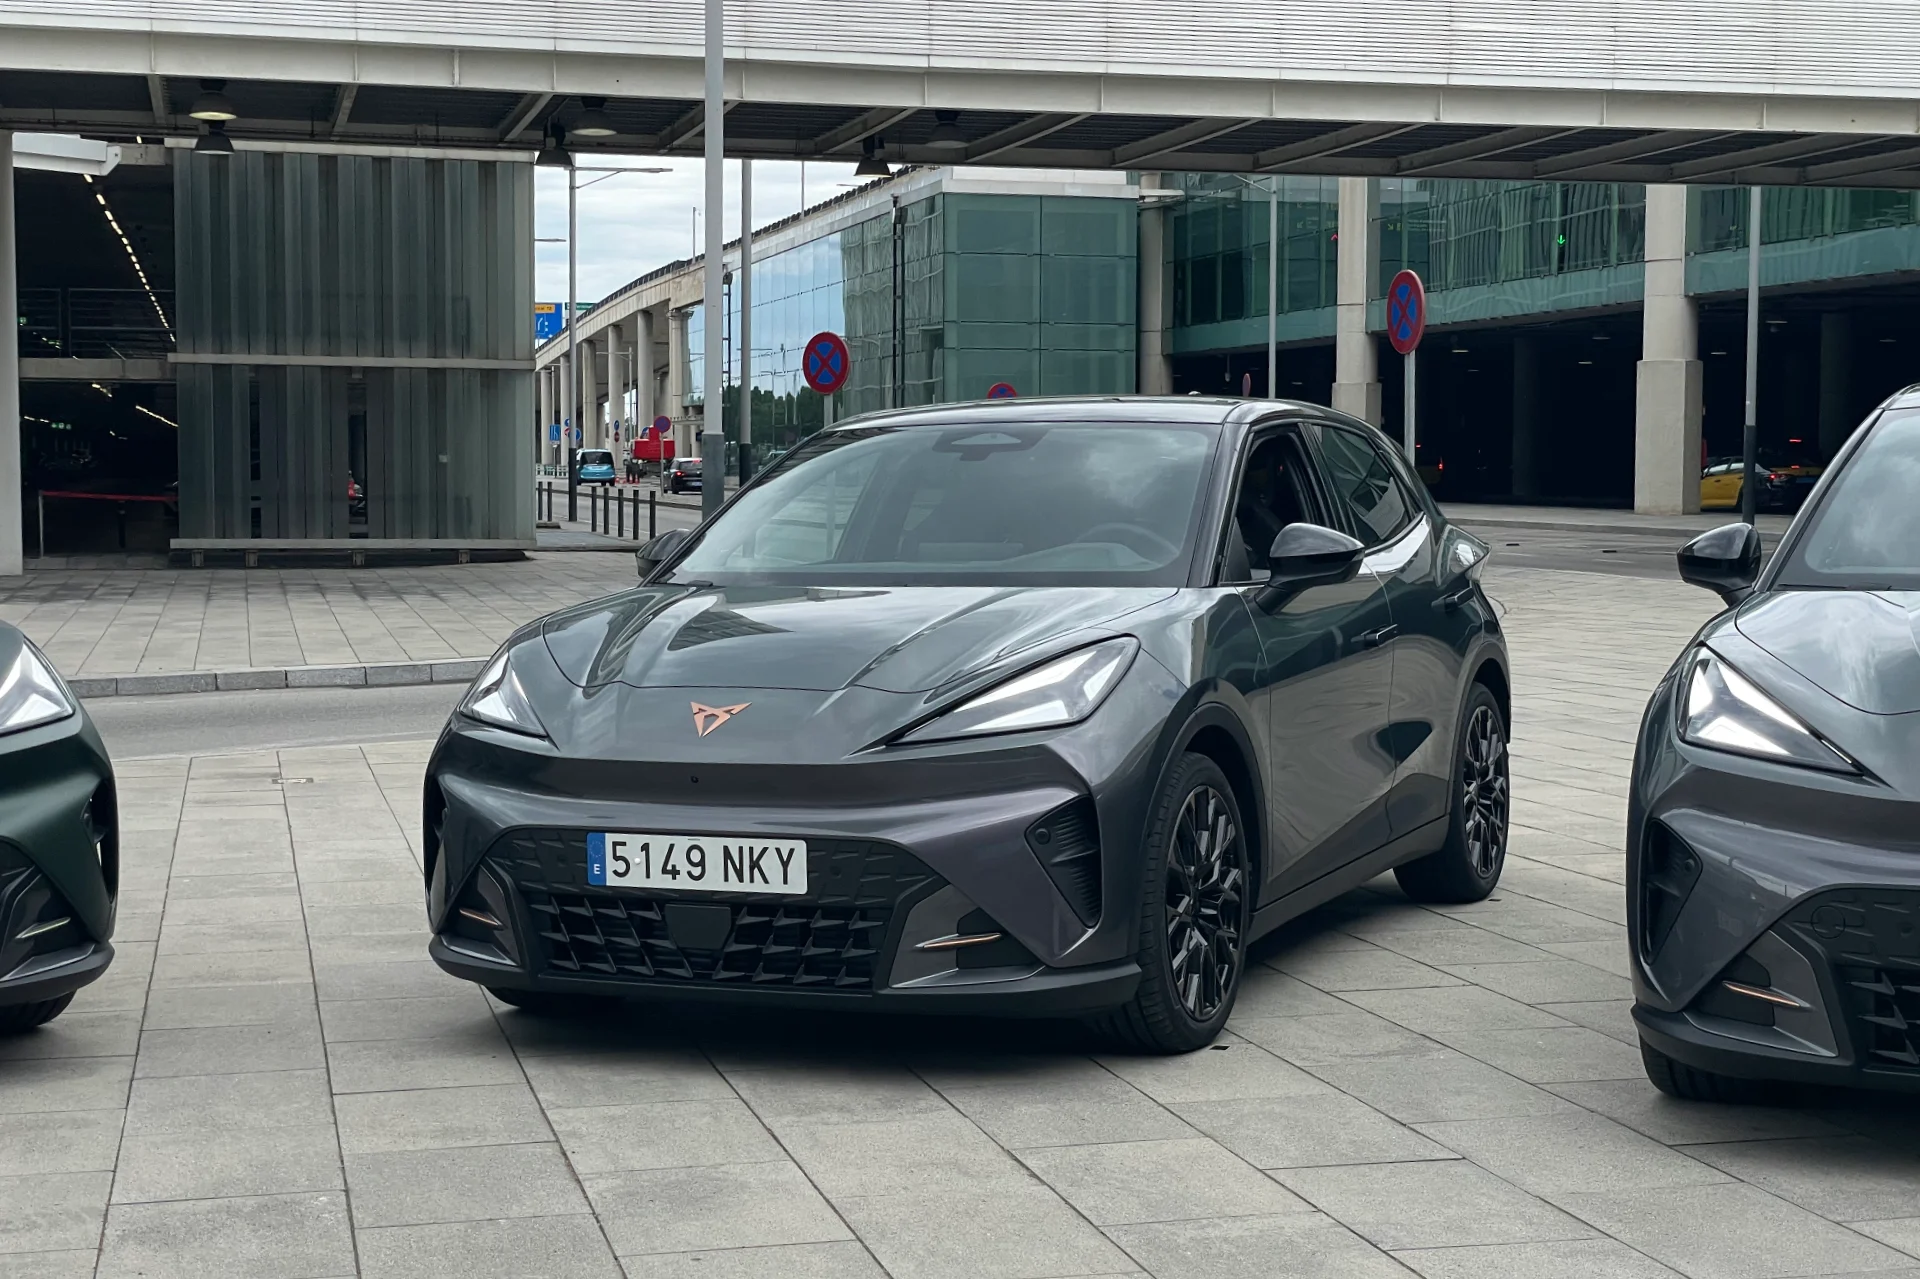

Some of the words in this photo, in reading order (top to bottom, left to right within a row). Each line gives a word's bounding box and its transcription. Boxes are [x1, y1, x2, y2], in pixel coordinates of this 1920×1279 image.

[594, 864, 601, 874] E
[611, 841, 706, 881] 5149
[722, 844, 796, 885] NKY
